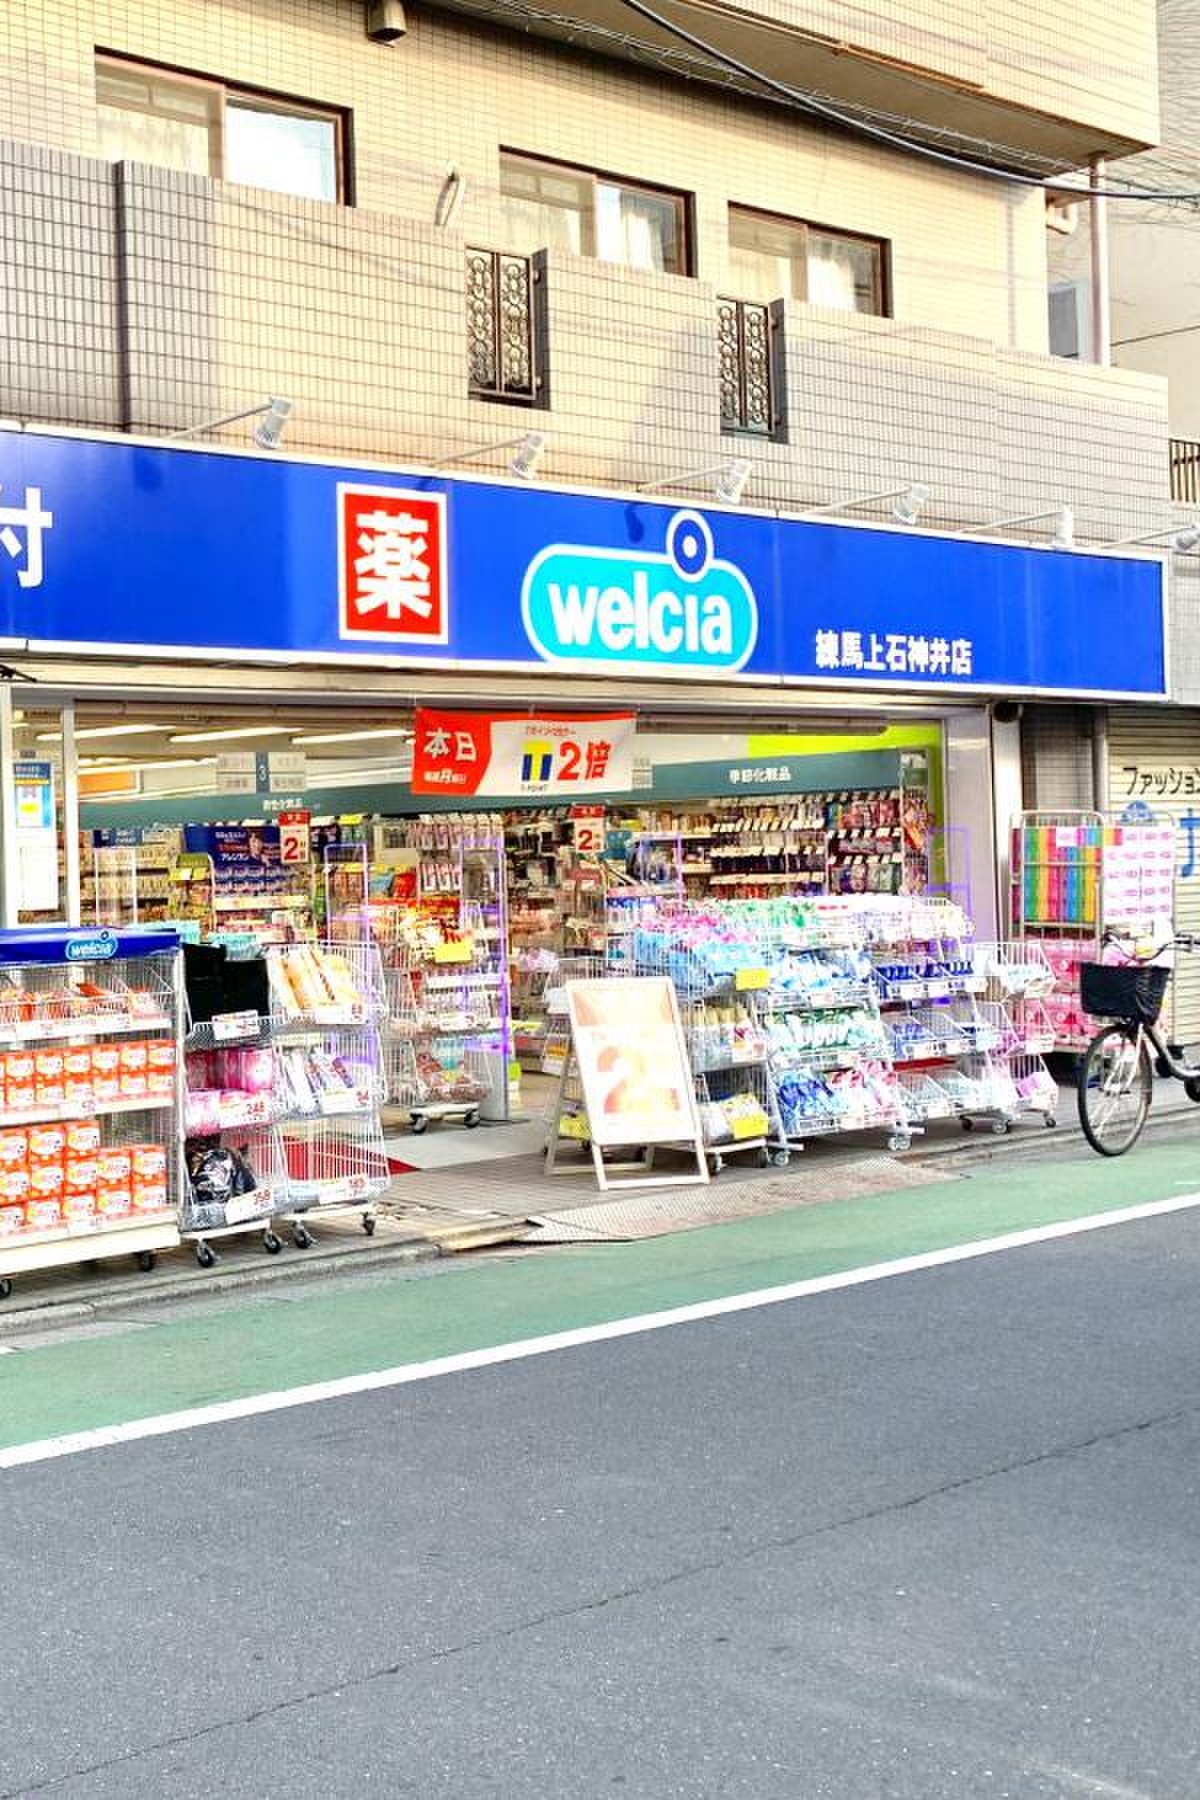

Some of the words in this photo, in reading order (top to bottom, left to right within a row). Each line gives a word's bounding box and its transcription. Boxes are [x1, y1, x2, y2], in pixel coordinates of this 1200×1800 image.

[353, 508, 433, 620] 薬
[547, 570, 733, 655] welcia
[815, 628, 973, 676] 練馬上石神井店
[423, 727, 477, 762] 本日
[557, 740, 612, 781] 2倍
